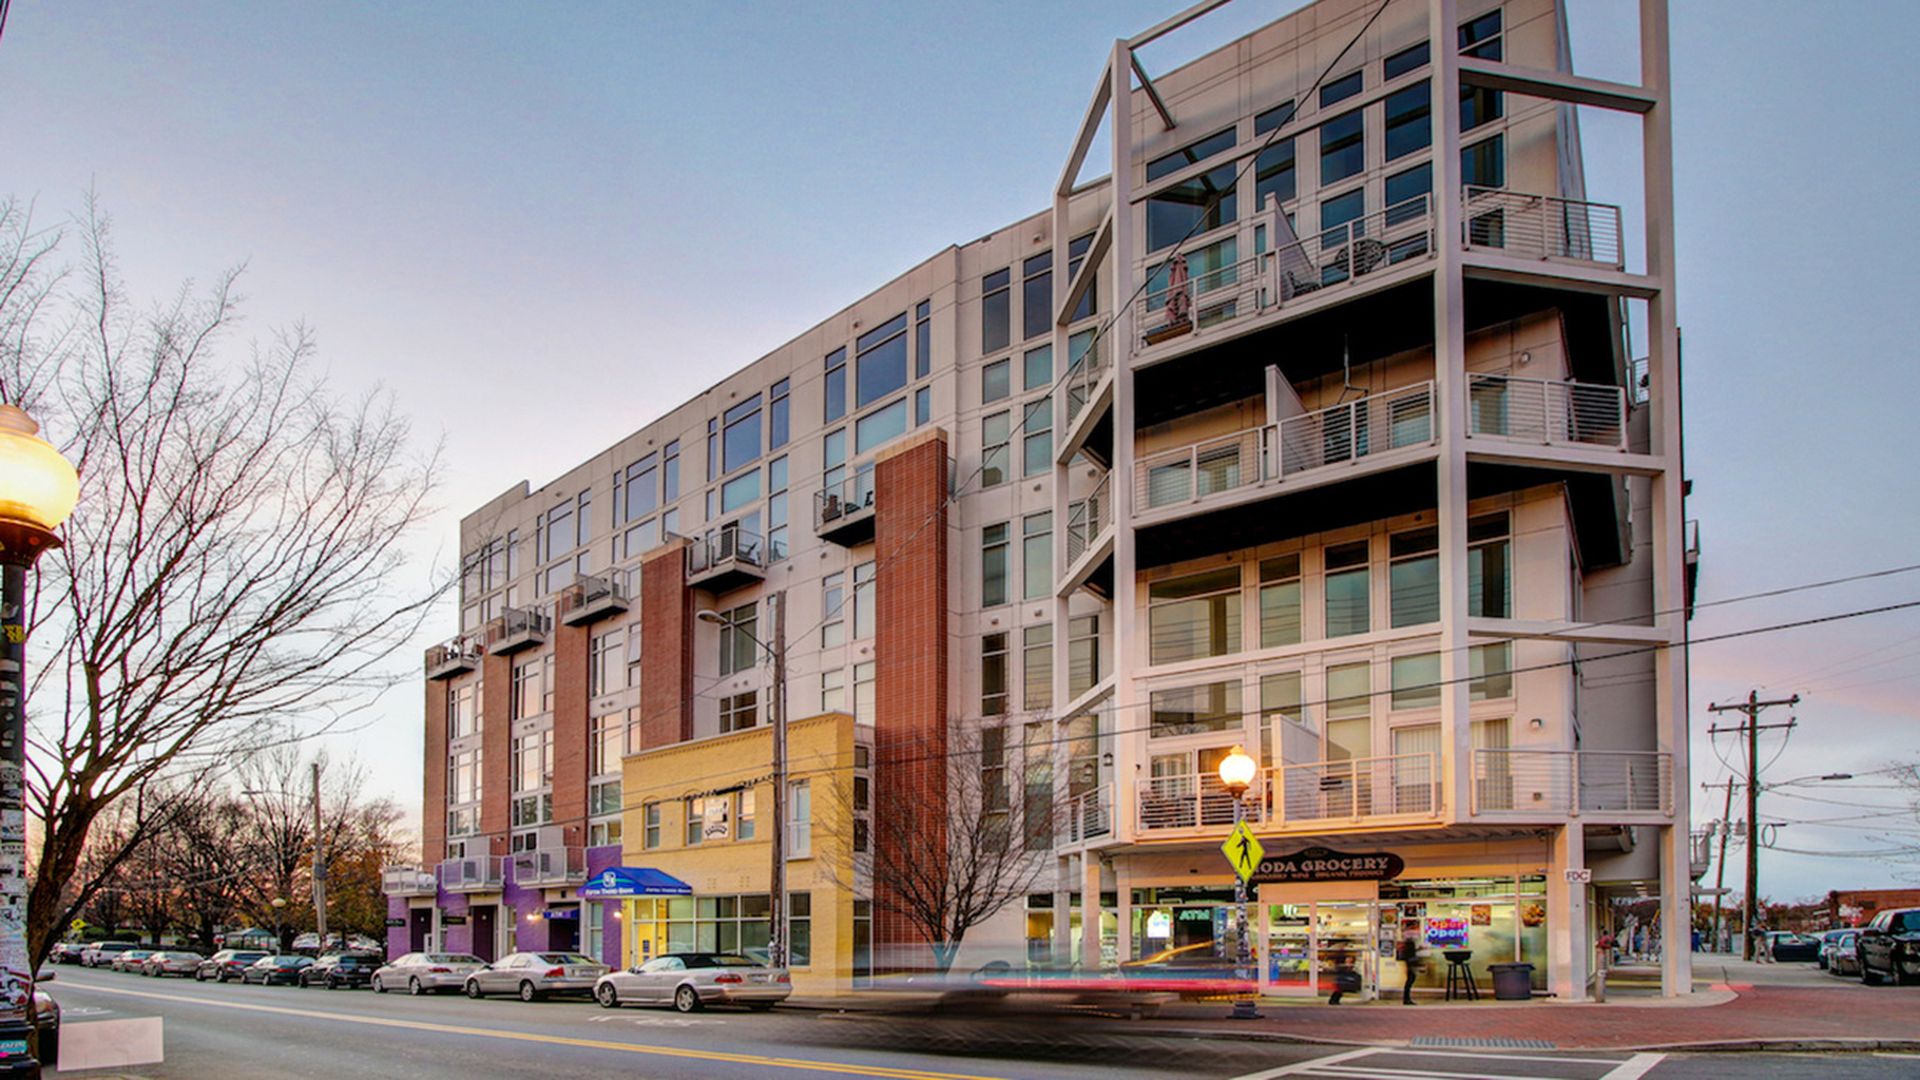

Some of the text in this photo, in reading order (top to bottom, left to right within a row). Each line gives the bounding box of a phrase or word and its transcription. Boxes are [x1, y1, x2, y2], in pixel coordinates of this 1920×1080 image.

[1255, 857, 1389, 874] ODA GROCERY
[1566, 871, 1588, 881] FDC
[1179, 909, 1210, 921] ATM
[1428, 928, 1465, 938] Open
